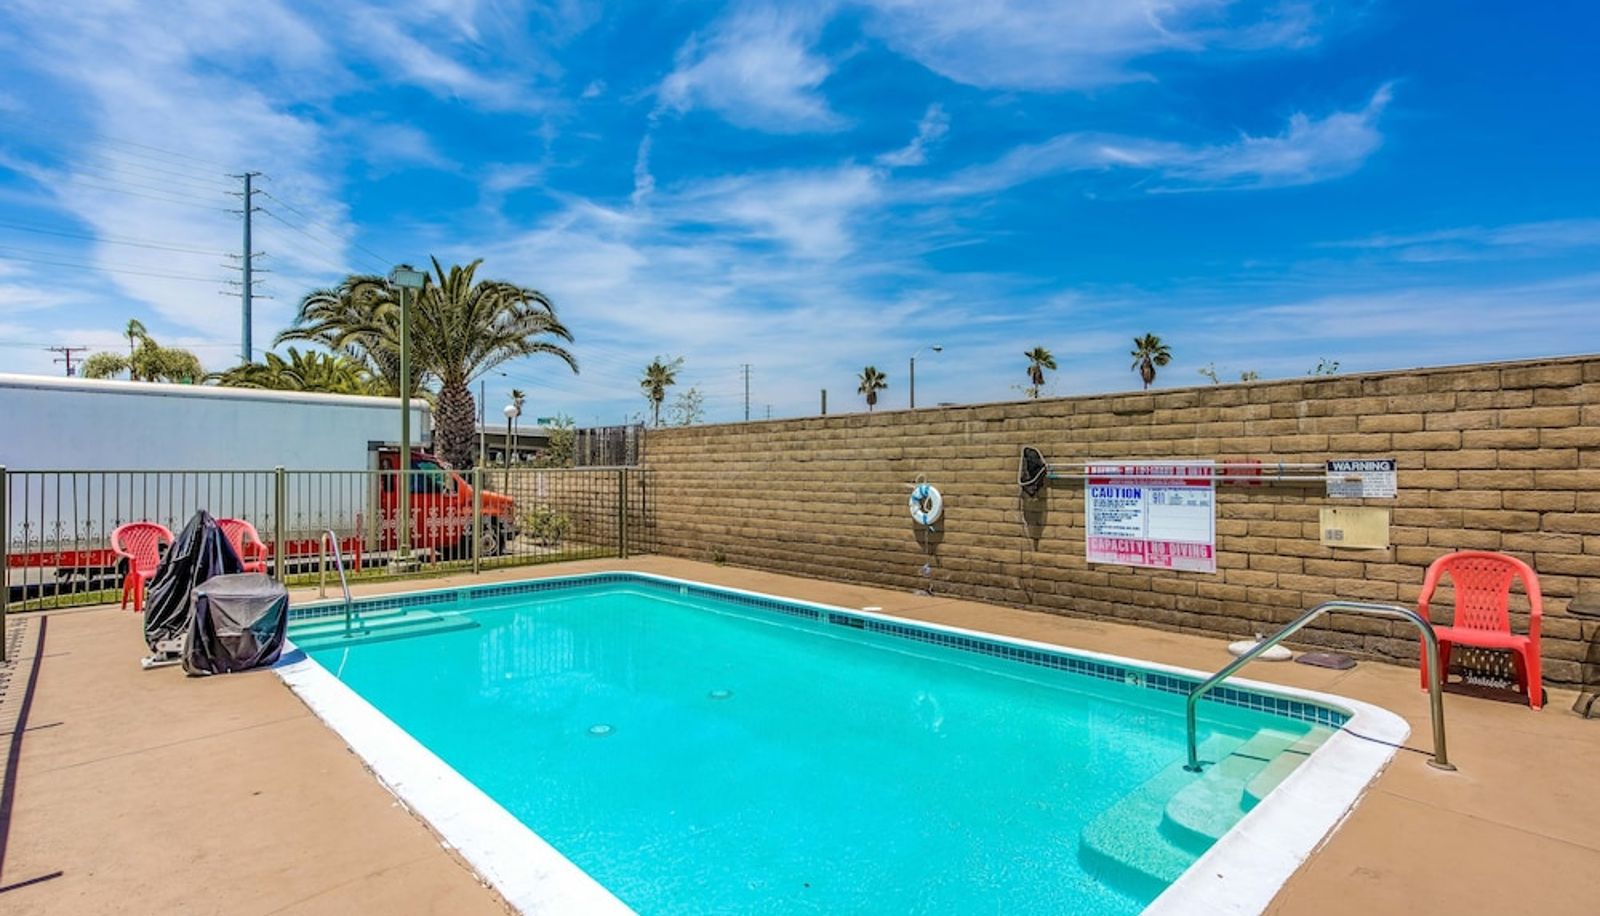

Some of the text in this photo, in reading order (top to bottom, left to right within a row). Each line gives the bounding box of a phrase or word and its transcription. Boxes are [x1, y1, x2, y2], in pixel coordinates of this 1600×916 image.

[1332, 461, 1391, 471] WARNING
[1091, 487, 1142, 499] CAUTION
[1091, 539, 1144, 554] CAPACITY
[1151, 541, 1207, 558] NO DIVING
